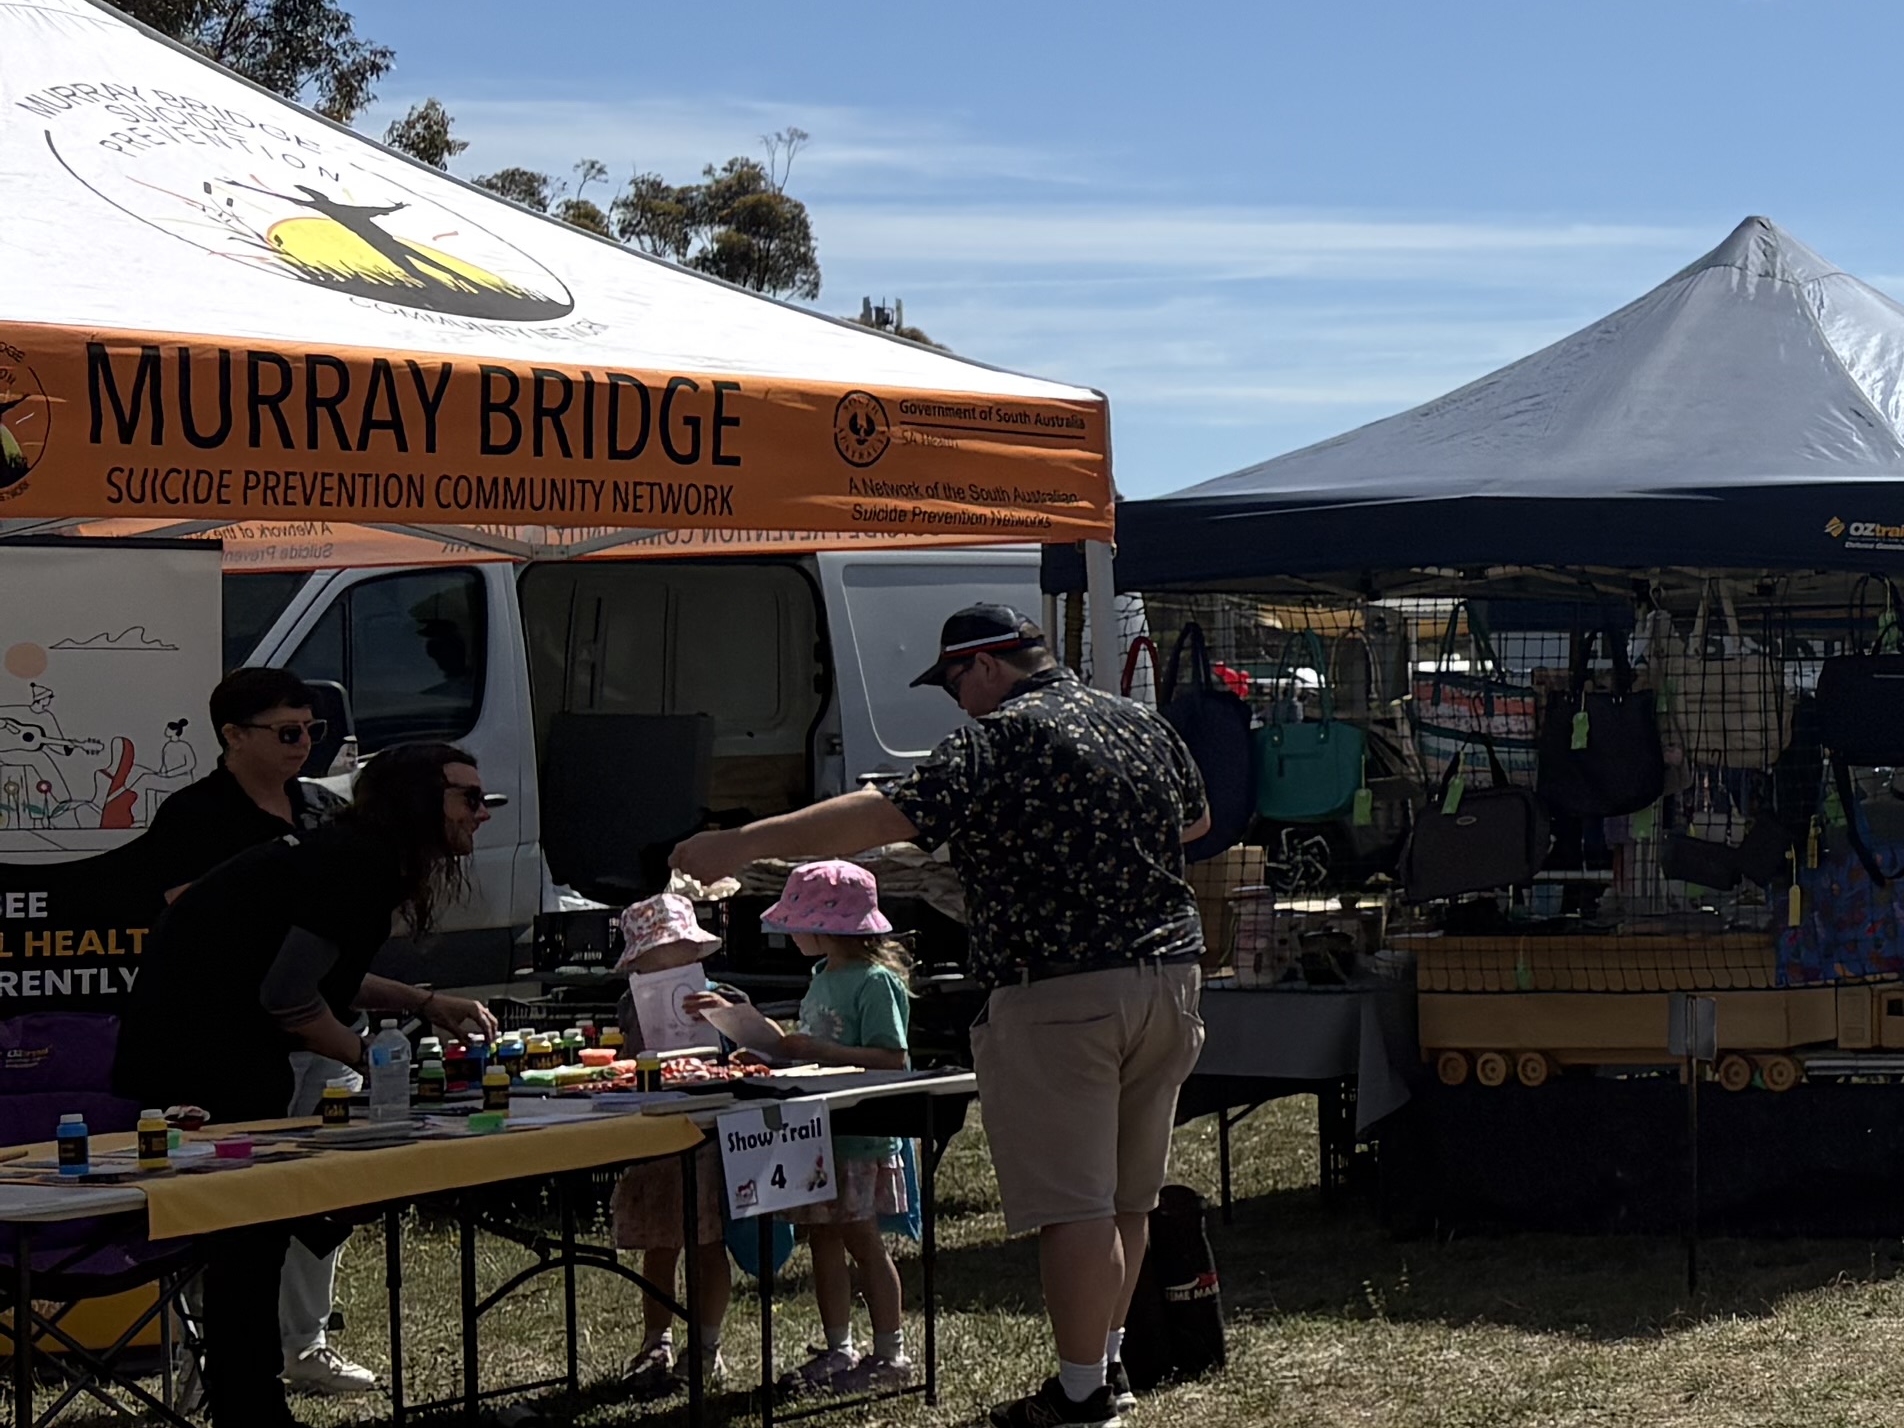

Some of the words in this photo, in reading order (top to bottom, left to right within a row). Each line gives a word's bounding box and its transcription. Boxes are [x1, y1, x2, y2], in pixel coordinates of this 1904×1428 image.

[16, 83, 147, 119] MURRAY
[152, 89, 321, 154] BRIDGE
[105, 104, 243, 138] SUICIDE
[100, 126, 340, 182] PREVENTION
[86, 341, 452, 453] MURRAY
[478, 364, 741, 466] BRIDGE
[900, 399, 976, 421] Government
[979, 406, 993, 421] of
[996, 410, 1032, 425] South
[1034, 412, 1086, 430] Australia
[106, 466, 232, 504] SUICIDE
[243, 470, 424, 508] PREVENTION
[435, 474, 605, 511] COMMUNITY
[612, 481, 733, 516] NETWORK
[849, 476, 860, 494] A
[862, 478, 918, 498] Network
[925, 483, 941, 500] of
[943, 484, 964, 501] the
[968, 486, 1010, 503] South
[1013, 490, 1078, 504] Australian
[852, 503, 907, 523] Suicide
[911, 507, 987, 527] Prevention
[0, 892, 48, 918] EE
[25, 928, 149, 957] HEALT
[0, 967, 139, 996] RENTLY
[727, 1131, 773, 1153] Show
[781, 1117, 822, 1143] Trail
[771, 1164, 787, 1189] 4
